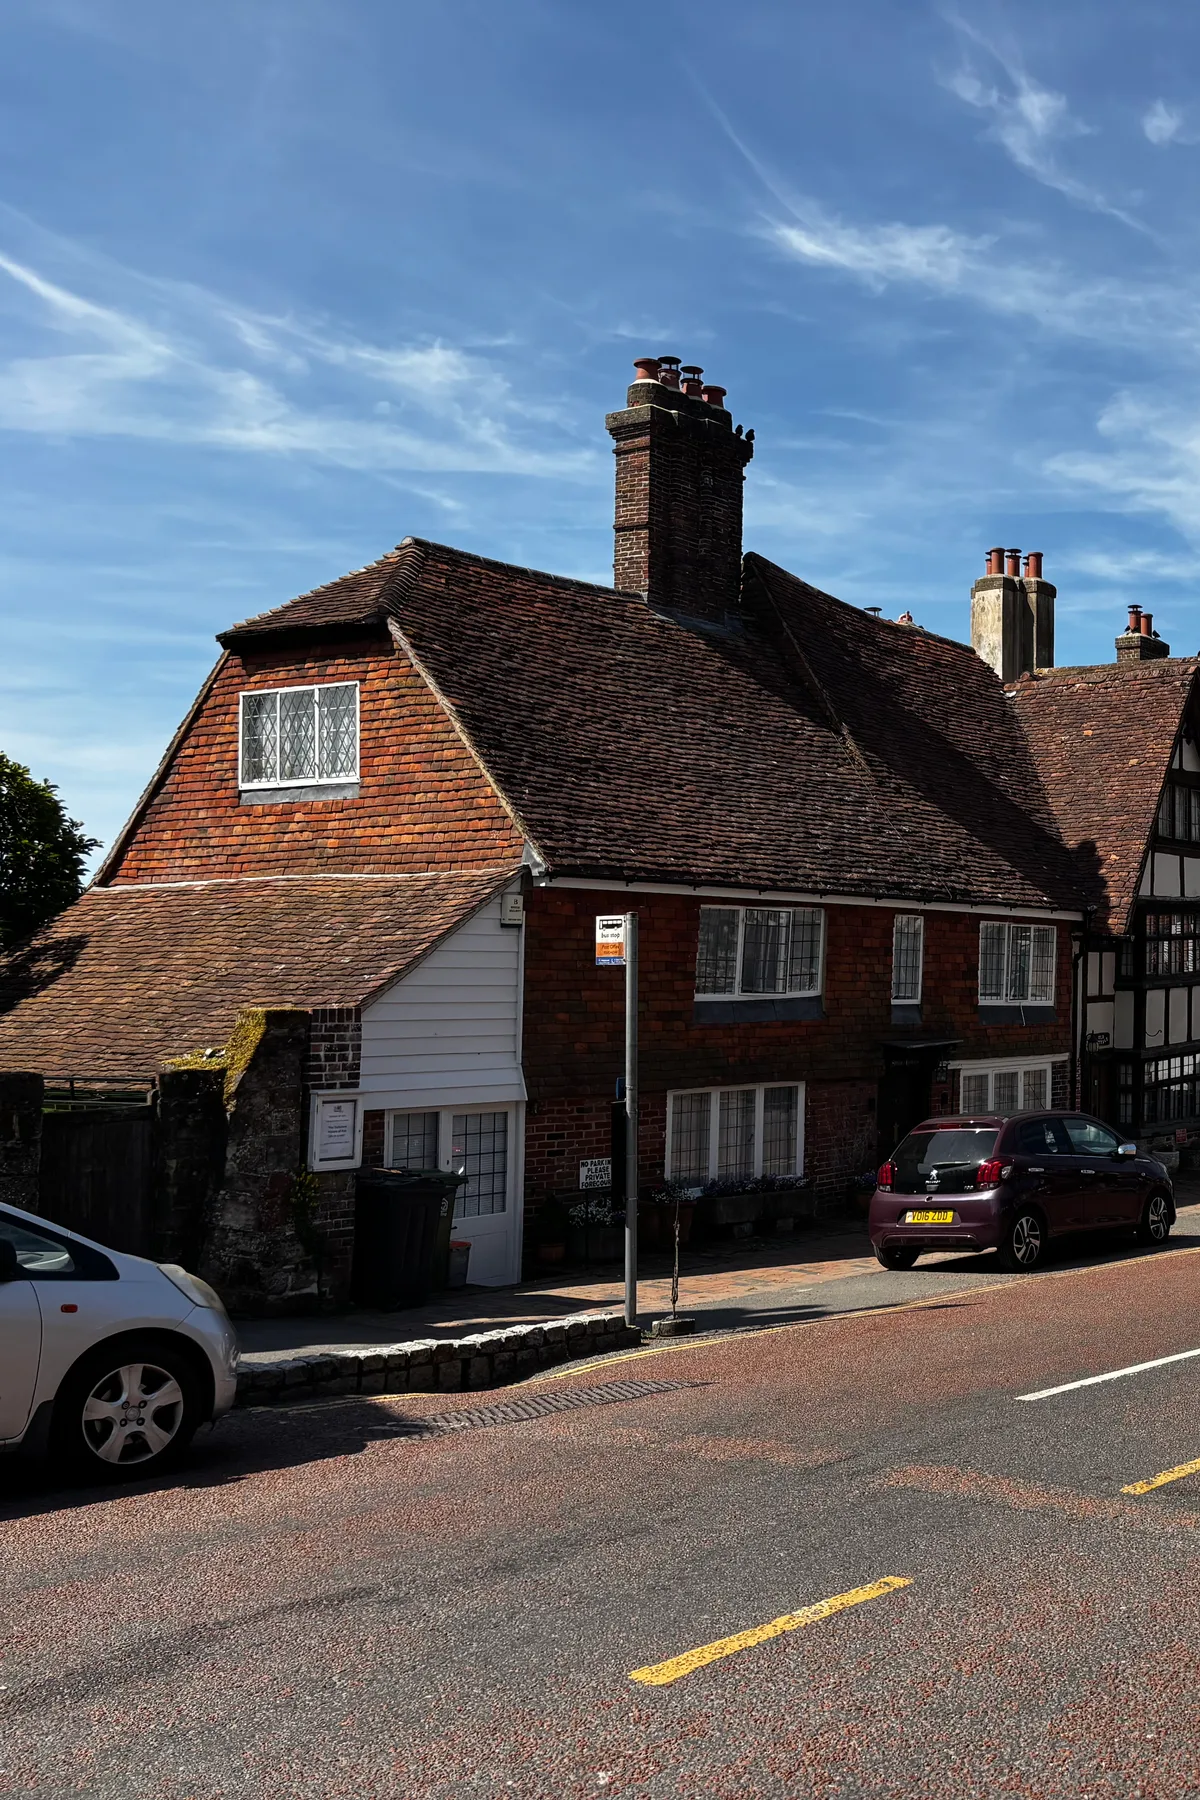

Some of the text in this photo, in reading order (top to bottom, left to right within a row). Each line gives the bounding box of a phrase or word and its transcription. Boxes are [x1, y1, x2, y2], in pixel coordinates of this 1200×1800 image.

[590, 1159, 612, 1167] PARKIN
[587, 1166, 610, 1174] PLEASE
[585, 1173, 610, 1181] PRIVATE
[581, 1180, 612, 1188] FORECOUR
[931, 1210, 948, 1221] ZDD
